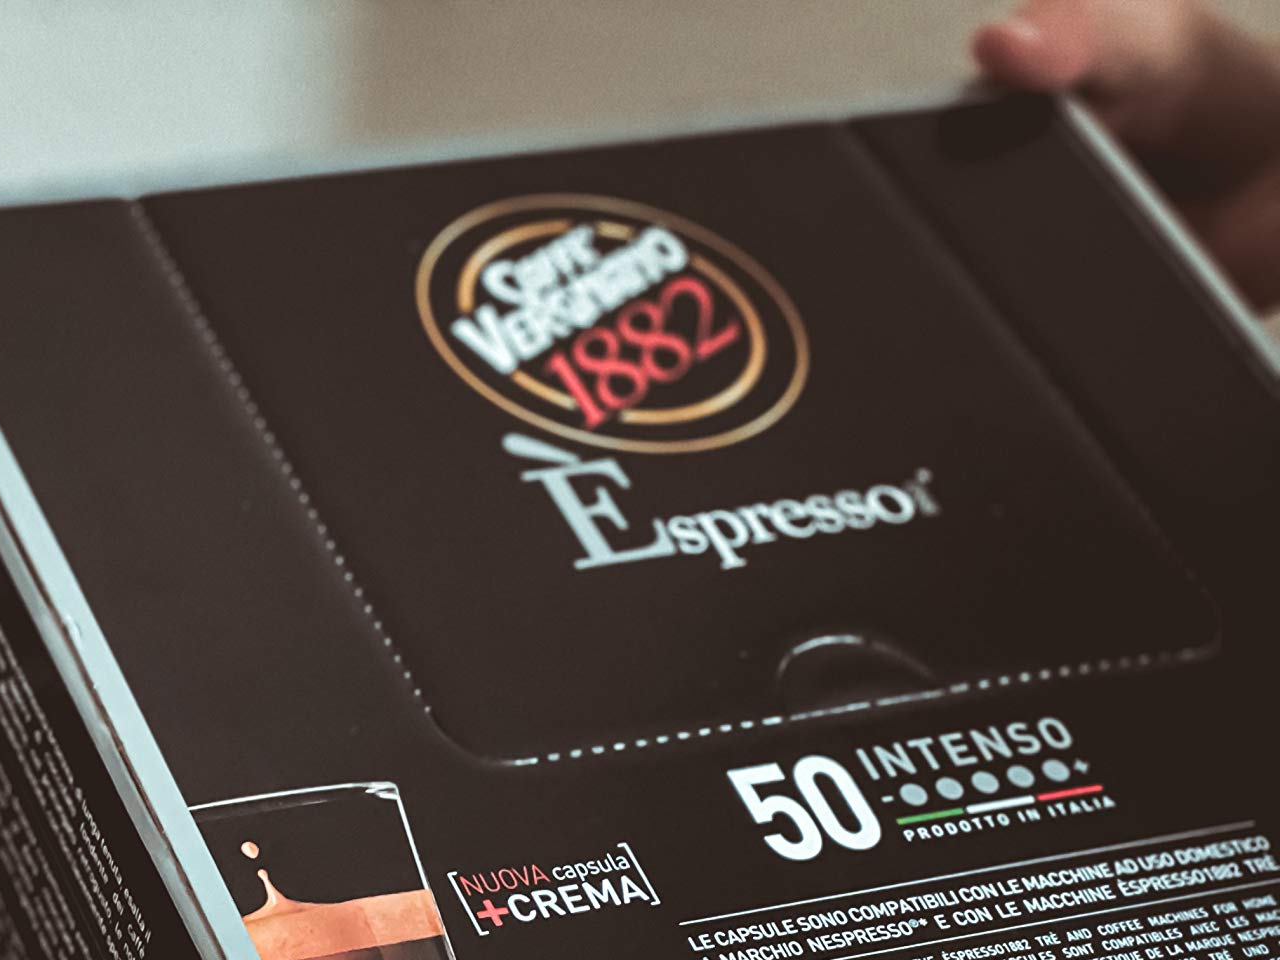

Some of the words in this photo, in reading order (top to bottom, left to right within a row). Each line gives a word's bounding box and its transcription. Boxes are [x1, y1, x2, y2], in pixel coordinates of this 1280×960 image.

[546, 276, 740, 430] 1882
[726, 755, 882, 860] 50
[856, 717, 1073, 780] INTENSO
[903, 812, 1010, 842] PRODOTTO
[1017, 808, 1041, 822] IN
[1047, 795, 1115, 817] ITALIA
[459, 864, 551, 896] NUOVA
[551, 853, 631, 881] capsula
[688, 934, 715, 951] LE
[714, 919, 798, 946] CAPSULE
[797, 910, 848, 931] SONO
[848, 890, 959, 922] COMPATIBILI
[958, 883, 999, 902] CON
[997, 879, 1023, 895] LE
[1021, 863, 1114, 891] MACCHINE
[1114, 859, 1139, 875] AD
[1137, 852, 1175, 871] USO
[1174, 836, 1269, 865] DOMESTICO
[934, 914, 951, 929] E
[953, 907, 993, 925] CON
[995, 901, 1022, 918] LE
[1023, 885, 1116, 913] MACCHINE
[1067, 928, 1092, 941] AND
[1097, 919, 1143, 936] COFFEE
[1147, 907, 1208, 926] MACHINES
[1213, 902, 1238, 914] FOR
[1062, 943, 1094, 958] SONT
[1102, 928, 1183, 951] COMPATIBLES
[1190, 921, 1219, 935] AVEC
[1226, 916, 1249, 928] LES
[1145, 947, 1164, 959] DE
[1165, 944, 1184, 955] LA
[1185, 934, 1235, 951] MARQUE
[1242, 944, 1269, 957] UND
